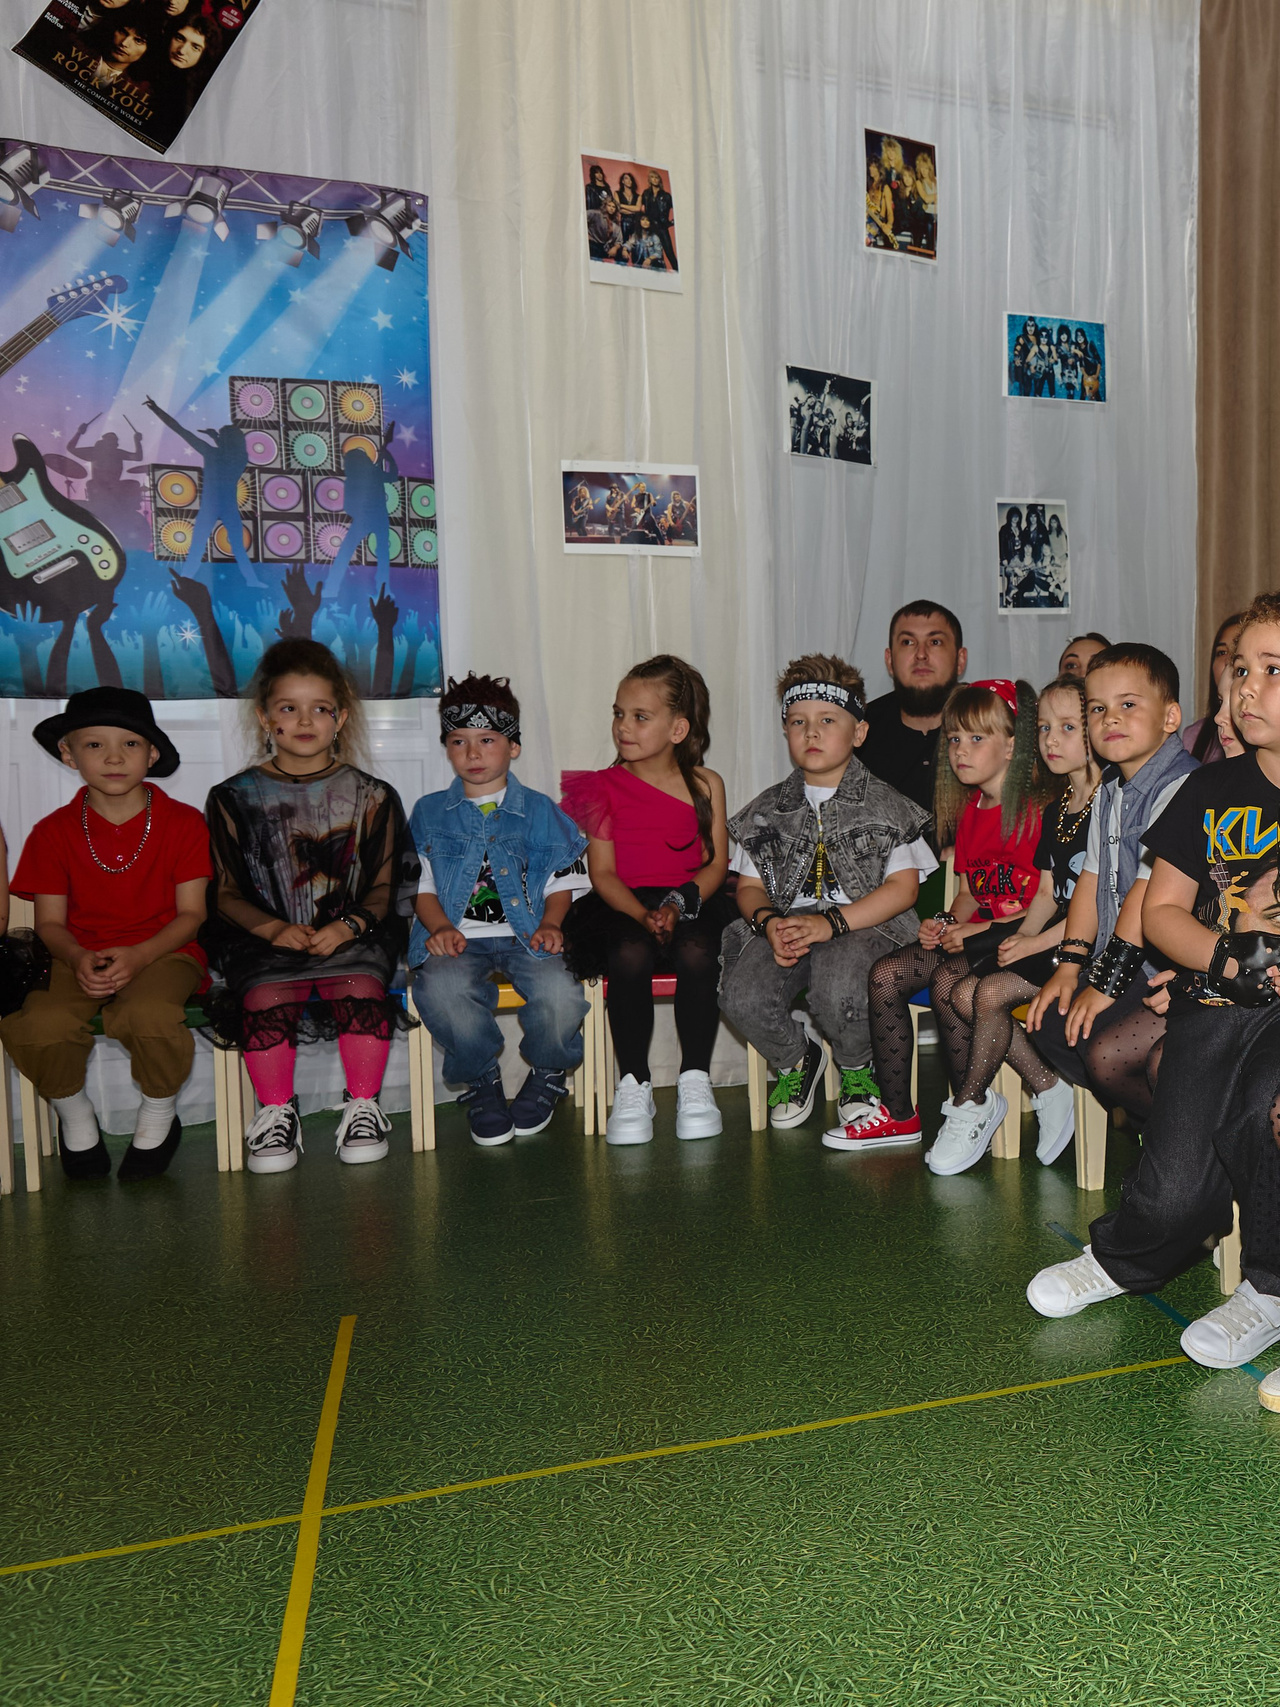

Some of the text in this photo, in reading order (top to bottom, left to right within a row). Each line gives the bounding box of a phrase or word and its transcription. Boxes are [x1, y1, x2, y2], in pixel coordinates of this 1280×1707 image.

[52, 51, 102, 89] ROCK
[109, 87, 153, 120] YOU!
[70, 46, 101, 72] WE
[105, 67, 150, 105] WILL
[73, 79, 142, 126] THE COMPLETE WORKS
